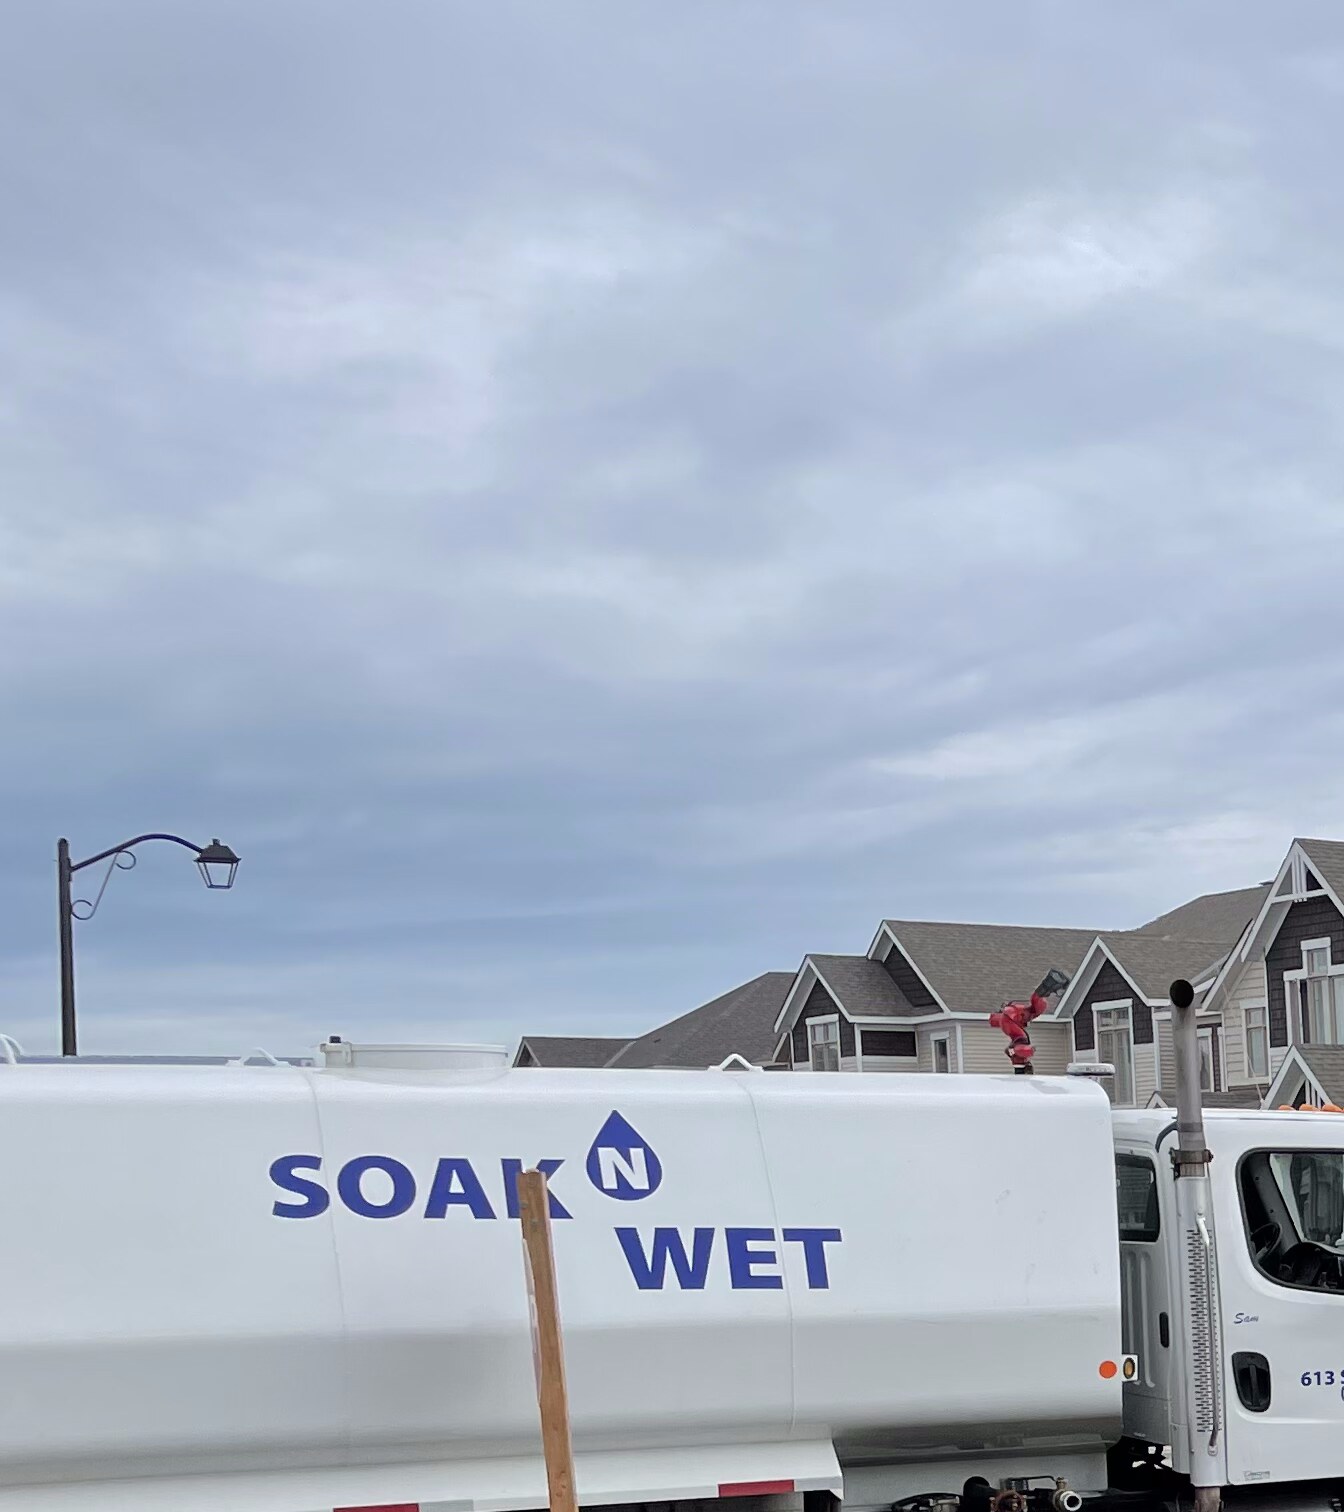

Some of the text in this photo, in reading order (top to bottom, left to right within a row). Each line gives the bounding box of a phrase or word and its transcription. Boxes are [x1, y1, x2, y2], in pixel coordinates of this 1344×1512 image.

[269, 1146, 651, 1219] SOAK N
[613, 1227, 842, 1289] WET
[1300, 1370, 1335, 1387] 613
